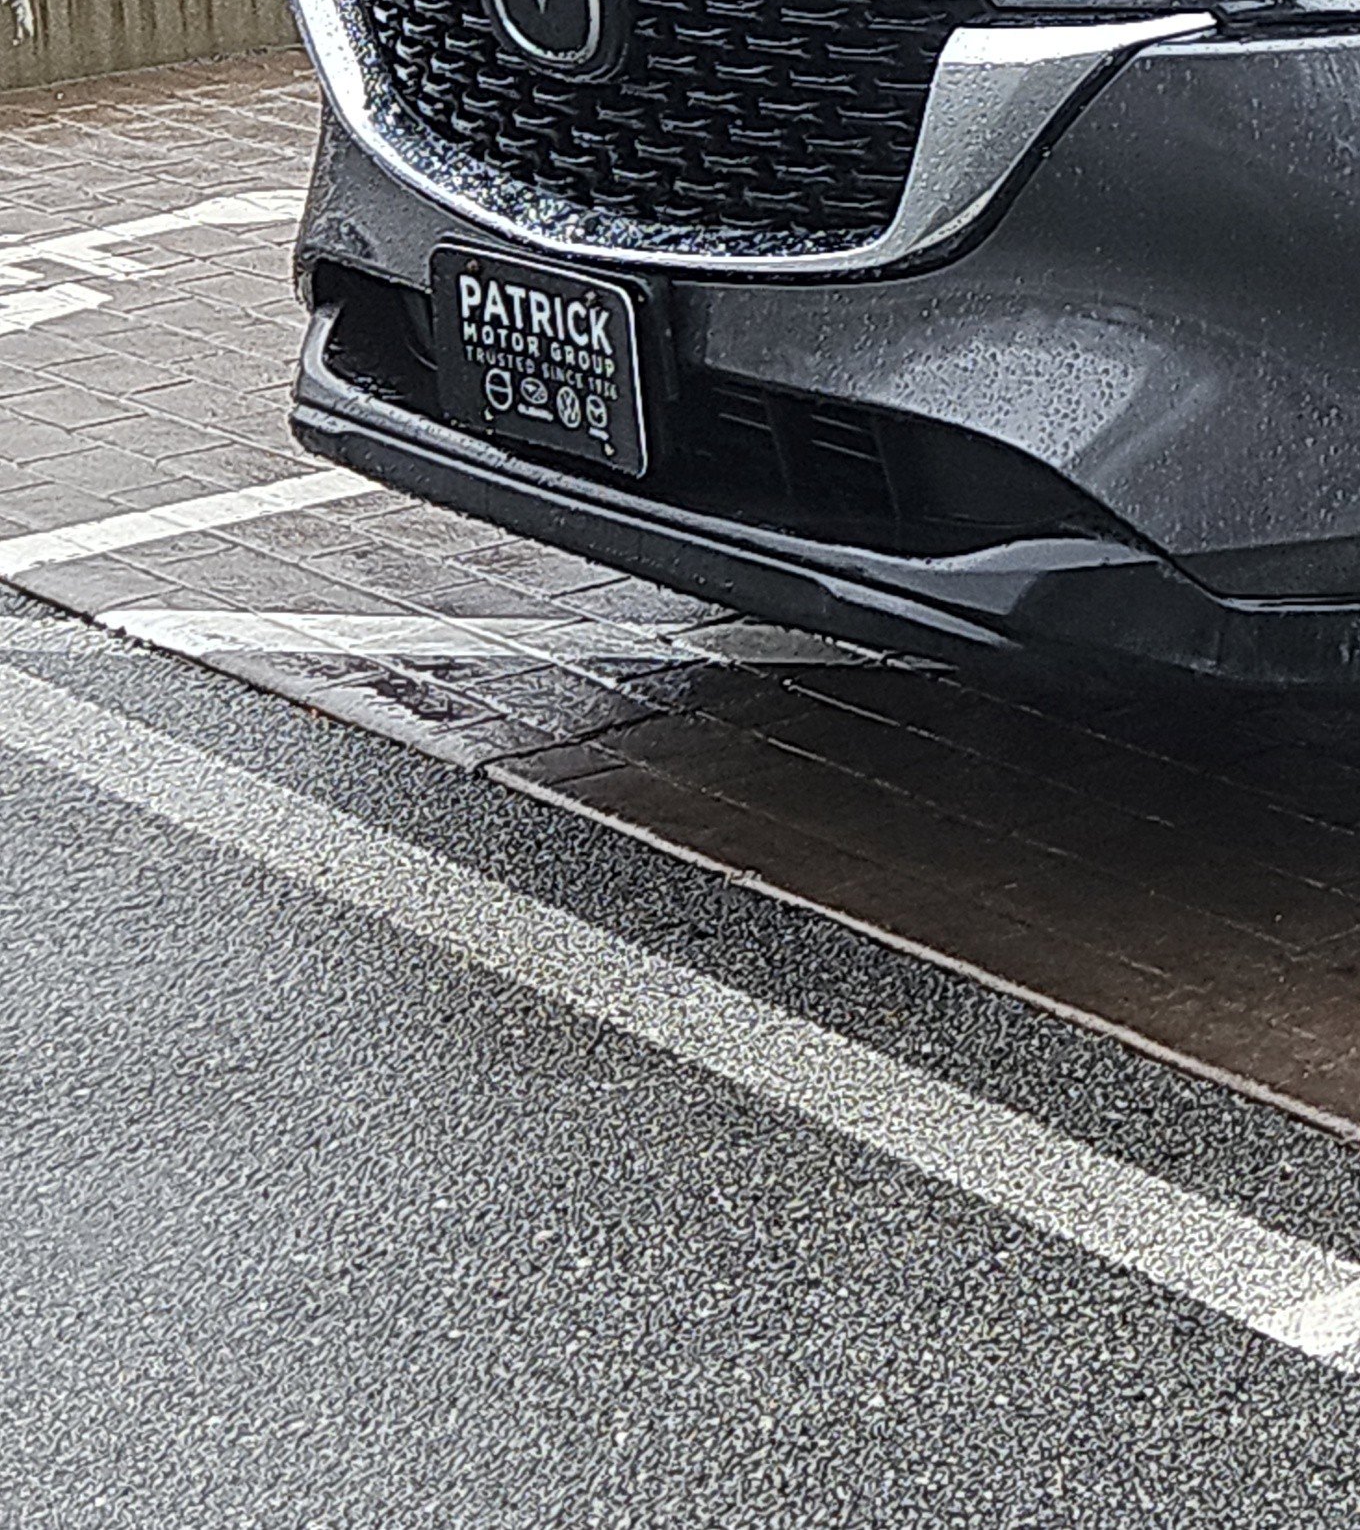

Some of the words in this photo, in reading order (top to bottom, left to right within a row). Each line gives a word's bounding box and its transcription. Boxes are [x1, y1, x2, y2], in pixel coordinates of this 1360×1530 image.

[459, 274, 613, 356] PATRICK
[463, 321, 540, 357] MOTOR
[550, 342, 615, 377] GROUP
[465, 345, 535, 374] TRUSTED
